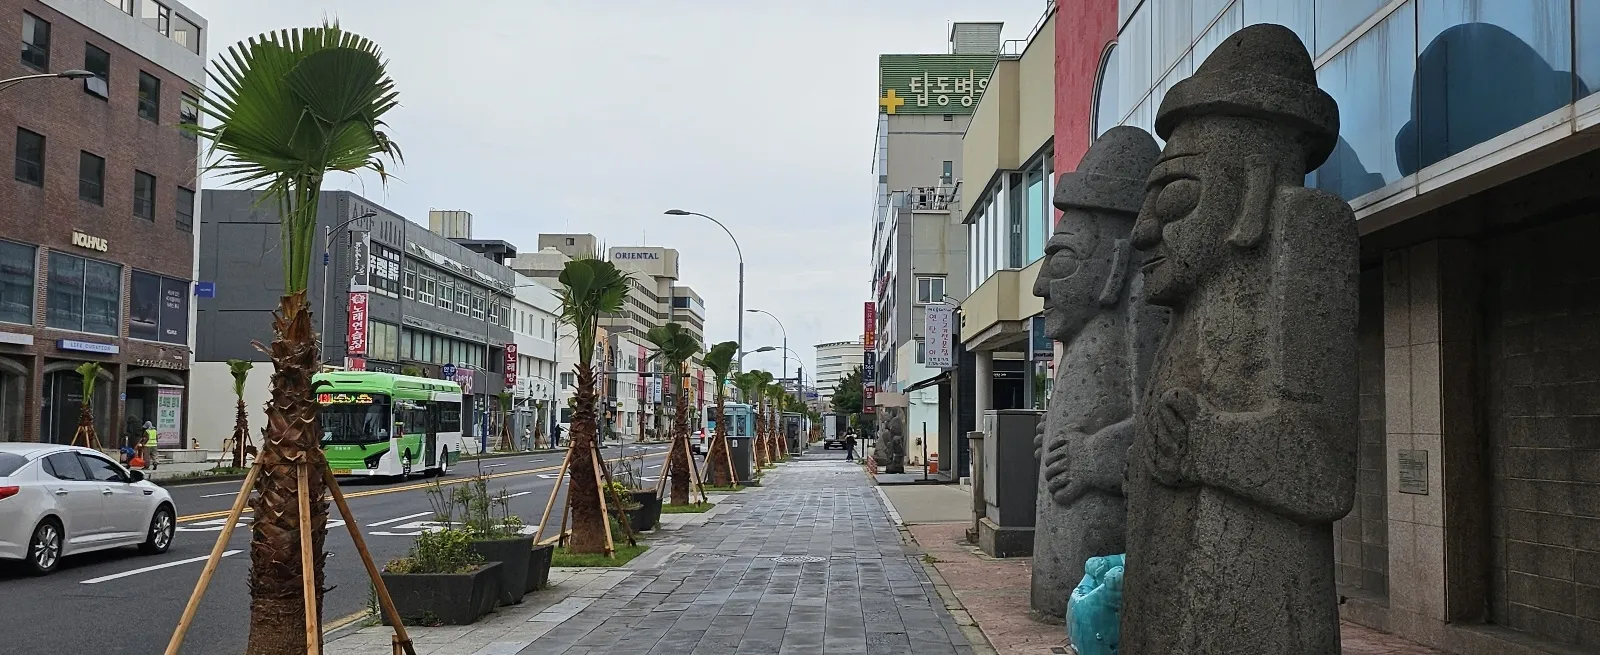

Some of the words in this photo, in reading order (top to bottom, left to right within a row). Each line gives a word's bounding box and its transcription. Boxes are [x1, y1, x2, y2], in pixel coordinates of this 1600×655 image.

[351, 305, 365, 348] 노래연습장
[928, 314, 937, 355] 연탄구이
[506, 354, 517, 382] 노래방
